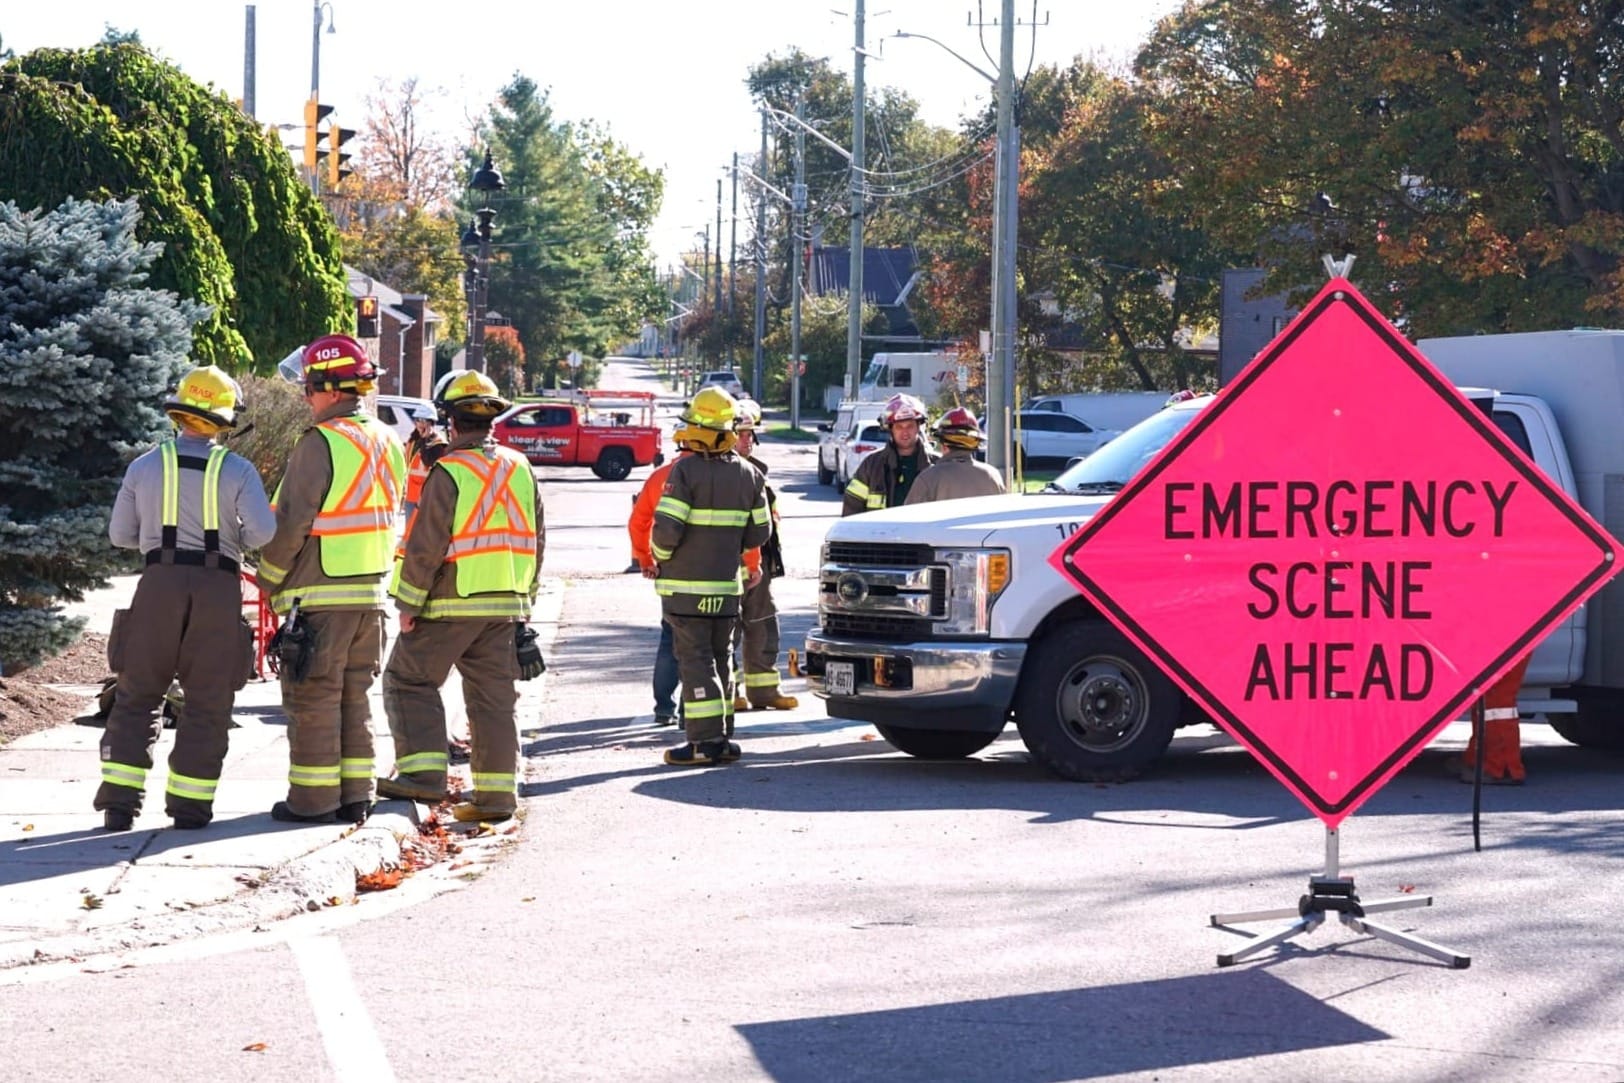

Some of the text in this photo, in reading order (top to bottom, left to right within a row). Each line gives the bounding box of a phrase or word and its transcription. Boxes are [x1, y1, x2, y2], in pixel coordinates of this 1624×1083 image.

[315, 348, 340, 361] 105
[546, 436, 570, 445] view
[1164, 480, 1519, 539] EMERGENCY
[697, 597, 724, 614] 4117
[1247, 561, 1432, 619] SCENE
[1244, 642, 1434, 701] AHEAD
